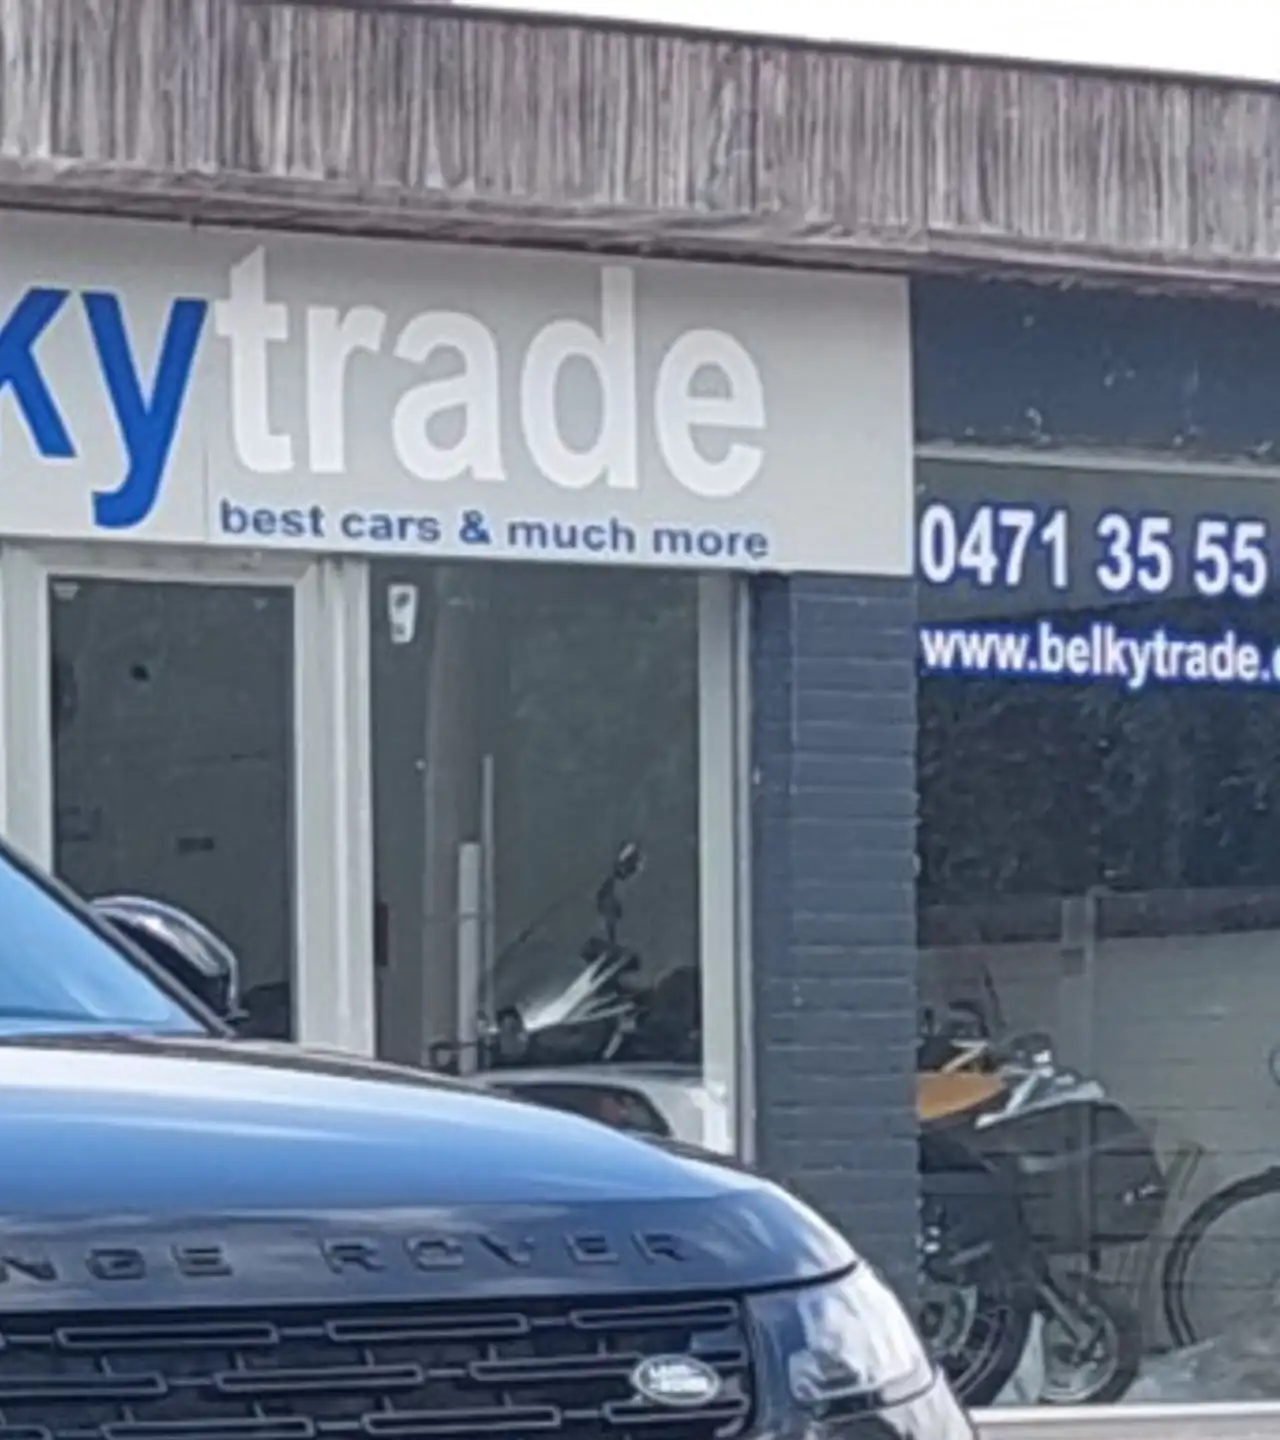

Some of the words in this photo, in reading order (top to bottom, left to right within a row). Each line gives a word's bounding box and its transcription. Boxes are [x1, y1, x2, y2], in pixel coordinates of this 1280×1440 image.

[220, 498, 325, 538] best
[340, 509, 441, 543] cars
[458, 509, 491, 545] &
[507, 516, 636, 554] much
[652, 524, 769, 559] more
[919, 503, 1069, 589] 0471
[1096, 511, 1174, 592] 35
[1193, 519, 1268, 597] 55
[318, 1231, 690, 1276] ROVER
